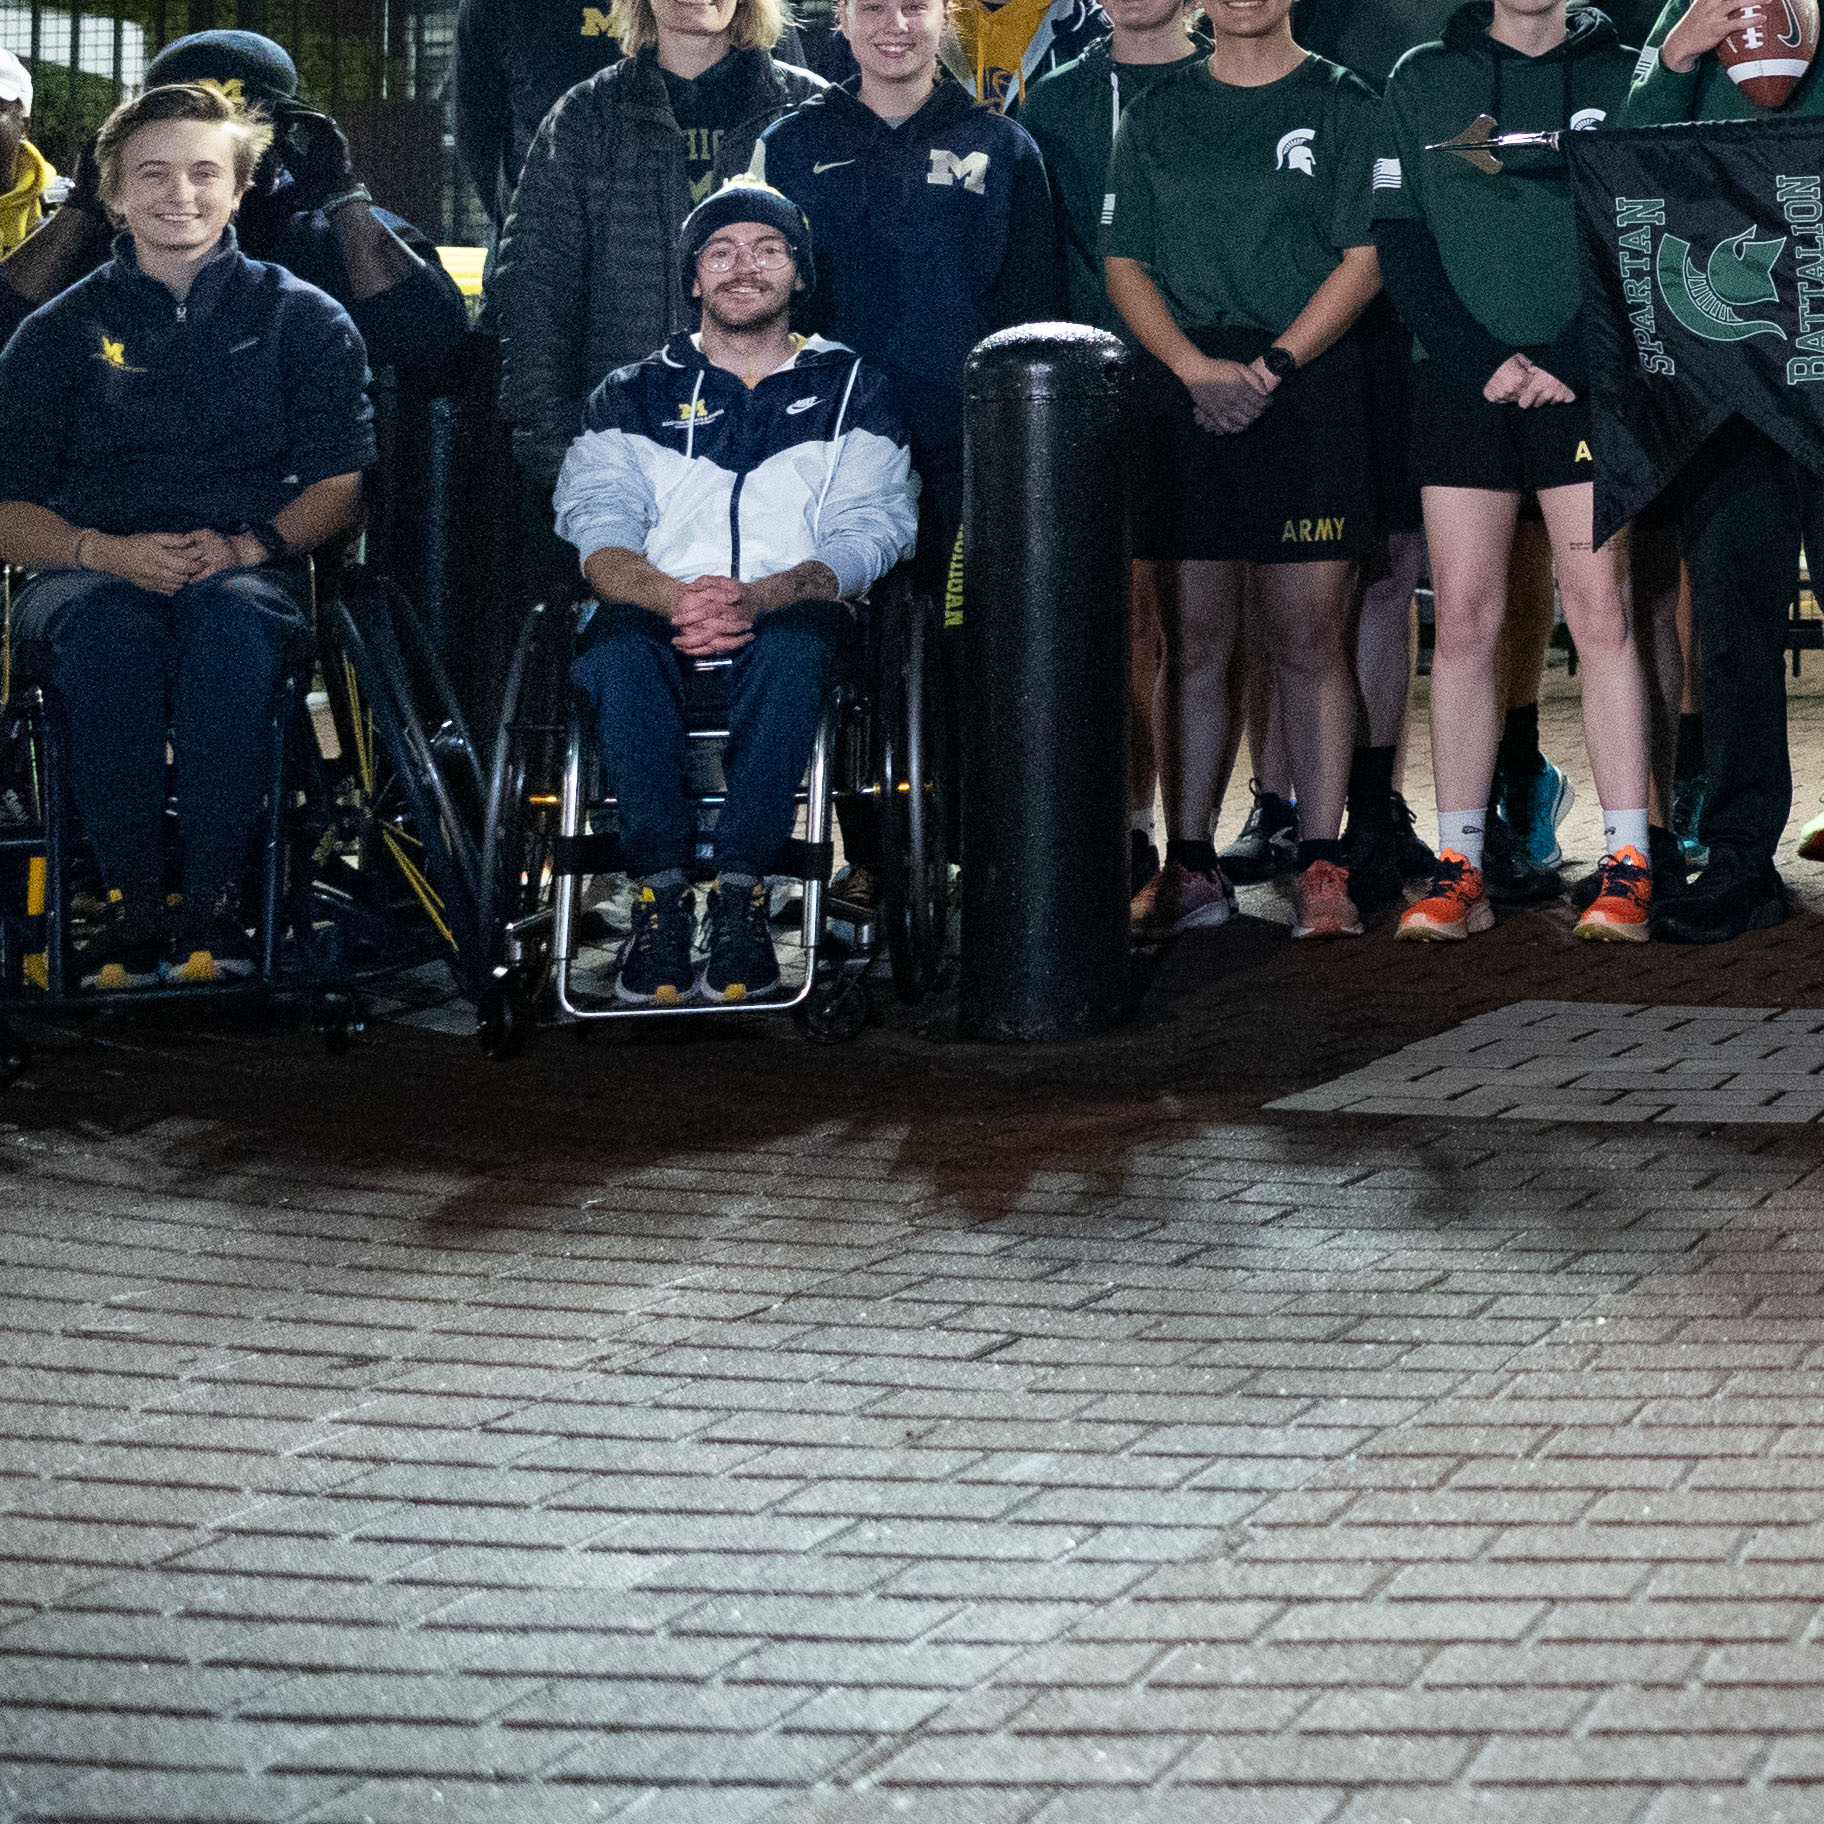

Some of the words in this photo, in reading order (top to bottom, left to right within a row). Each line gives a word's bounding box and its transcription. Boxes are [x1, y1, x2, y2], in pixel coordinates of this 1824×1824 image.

[927, 149, 990, 196] M
[1615, 197, 1676, 377] SPARTAN
[1281, 516, 1346, 543] ARMY
